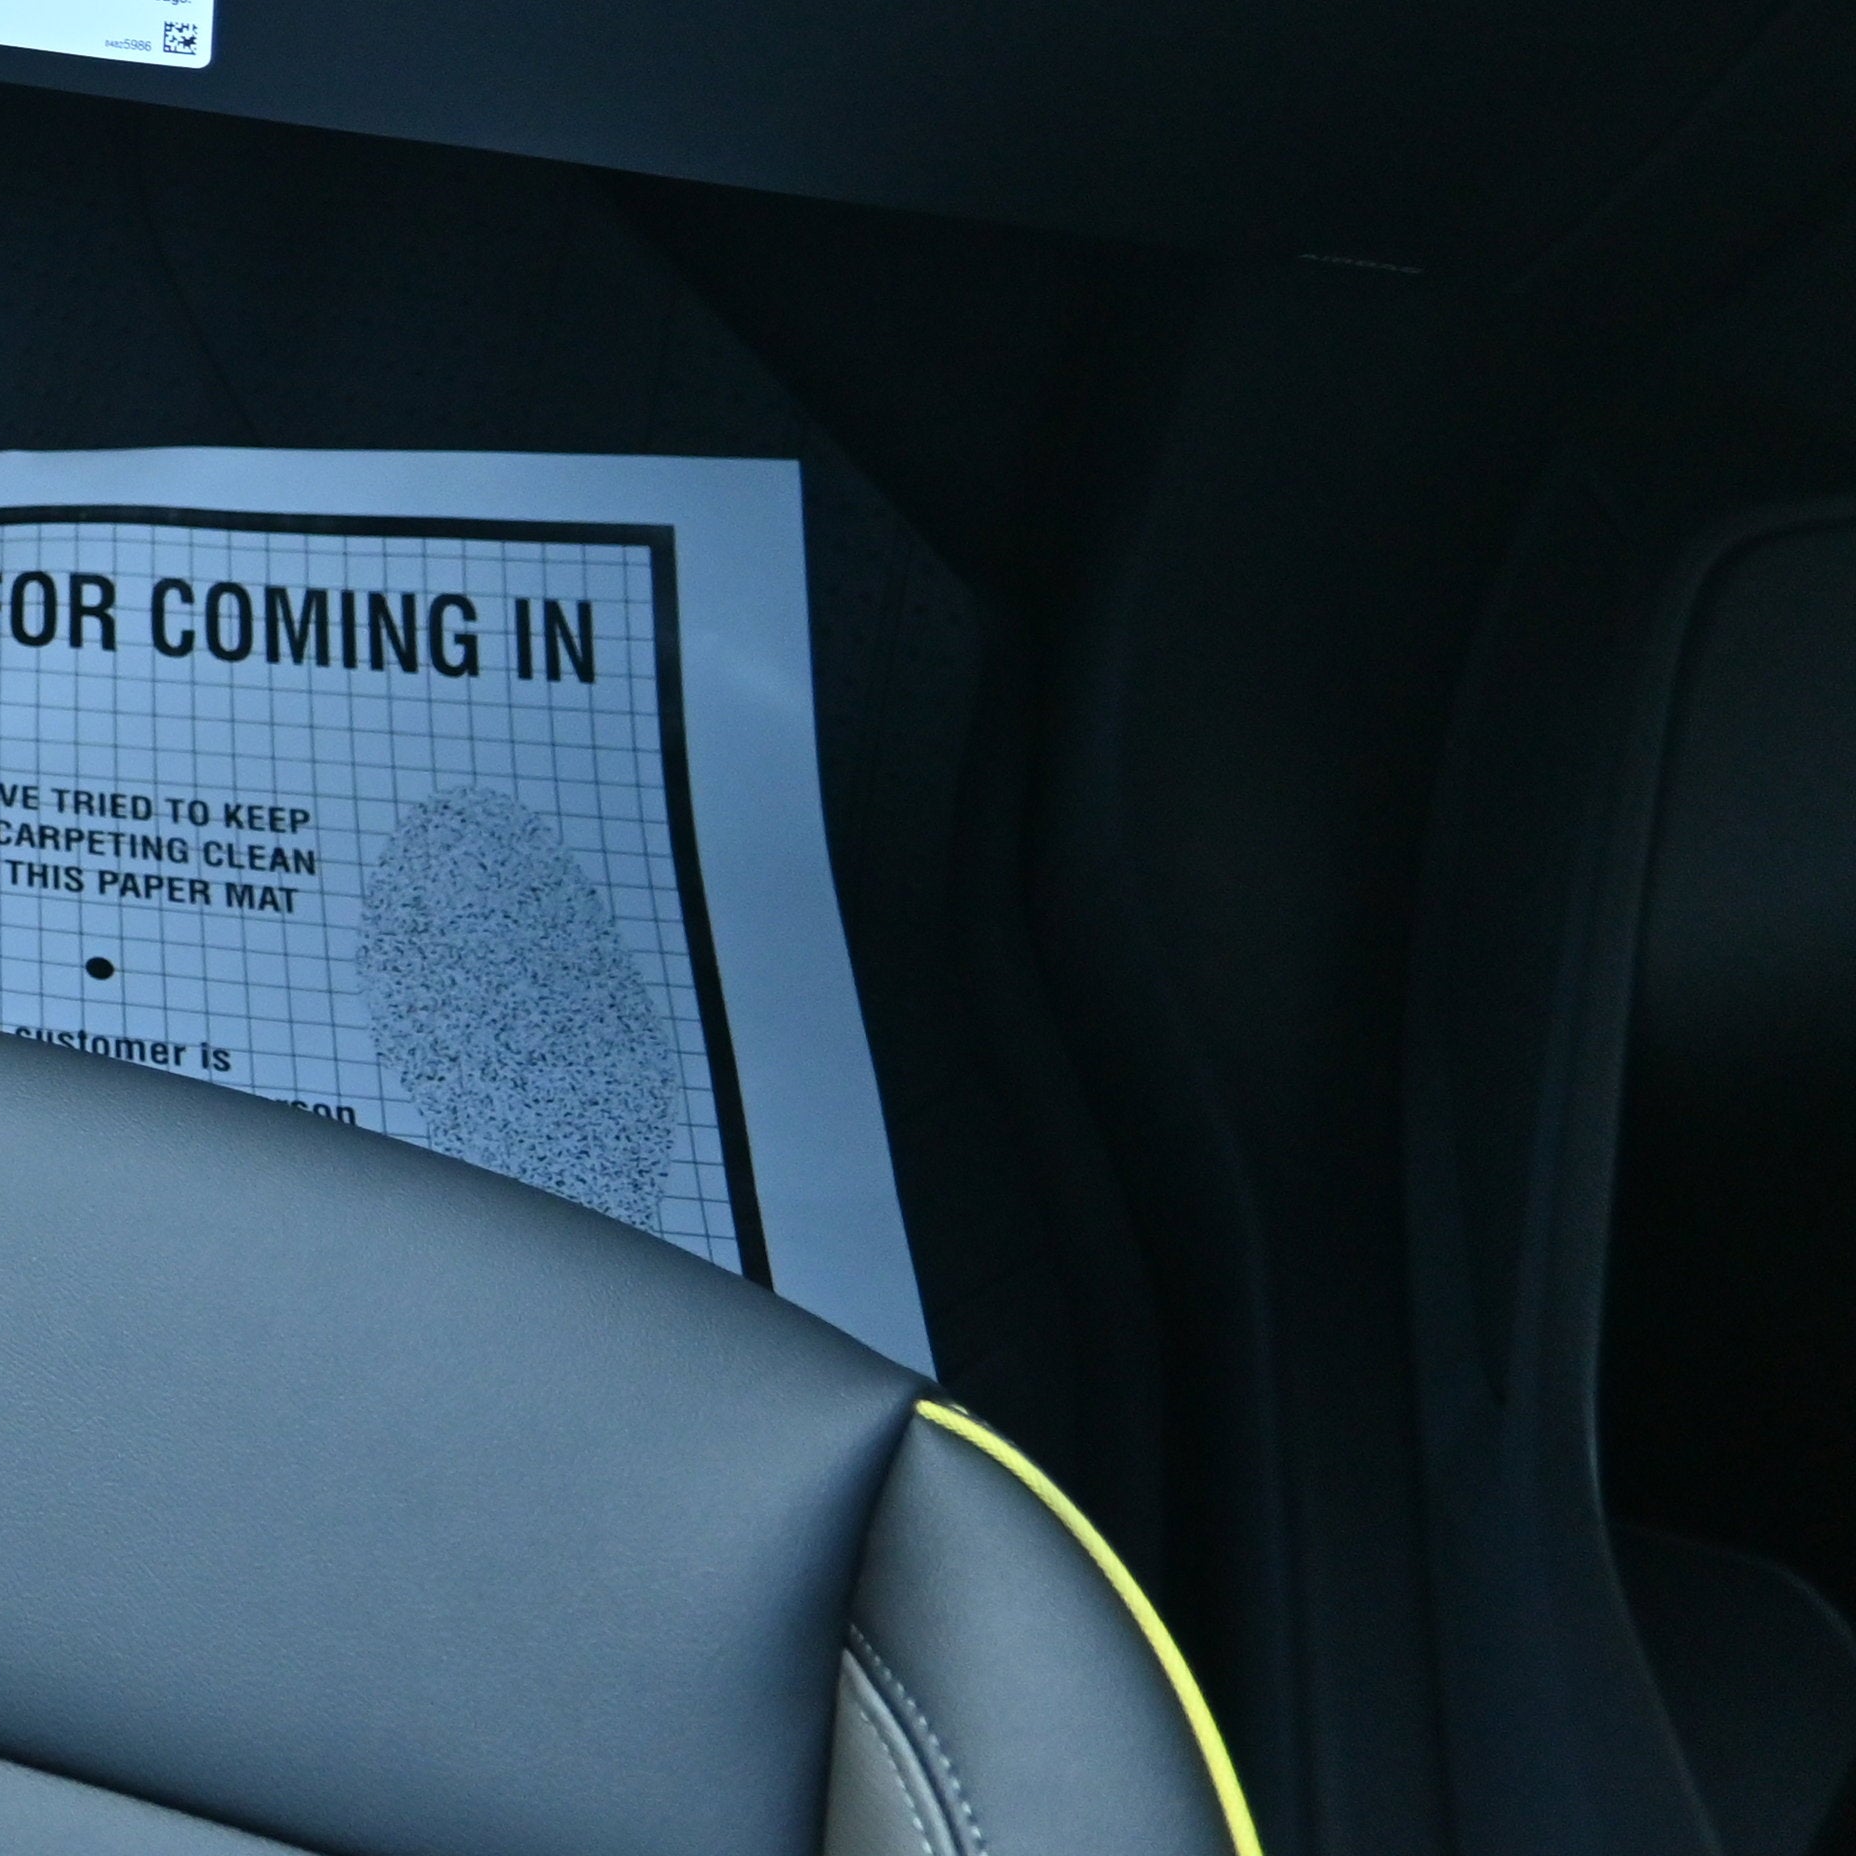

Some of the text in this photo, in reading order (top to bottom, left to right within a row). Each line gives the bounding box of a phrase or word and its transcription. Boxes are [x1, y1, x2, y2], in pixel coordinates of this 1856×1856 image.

[150, 577, 482, 679] COMING
[514, 597, 597, 685] IN
[51, 786, 153, 822] TRIED
[165, 796, 210, 828] TO
[223, 801, 312, 835] KEEP
[202, 839, 317, 876] CLEAN
[3, 858, 86, 893] THIS
[97, 868, 211, 907] PAPER
[224, 881, 298, 914] MAT
[201, 1042, 232, 1073] is
